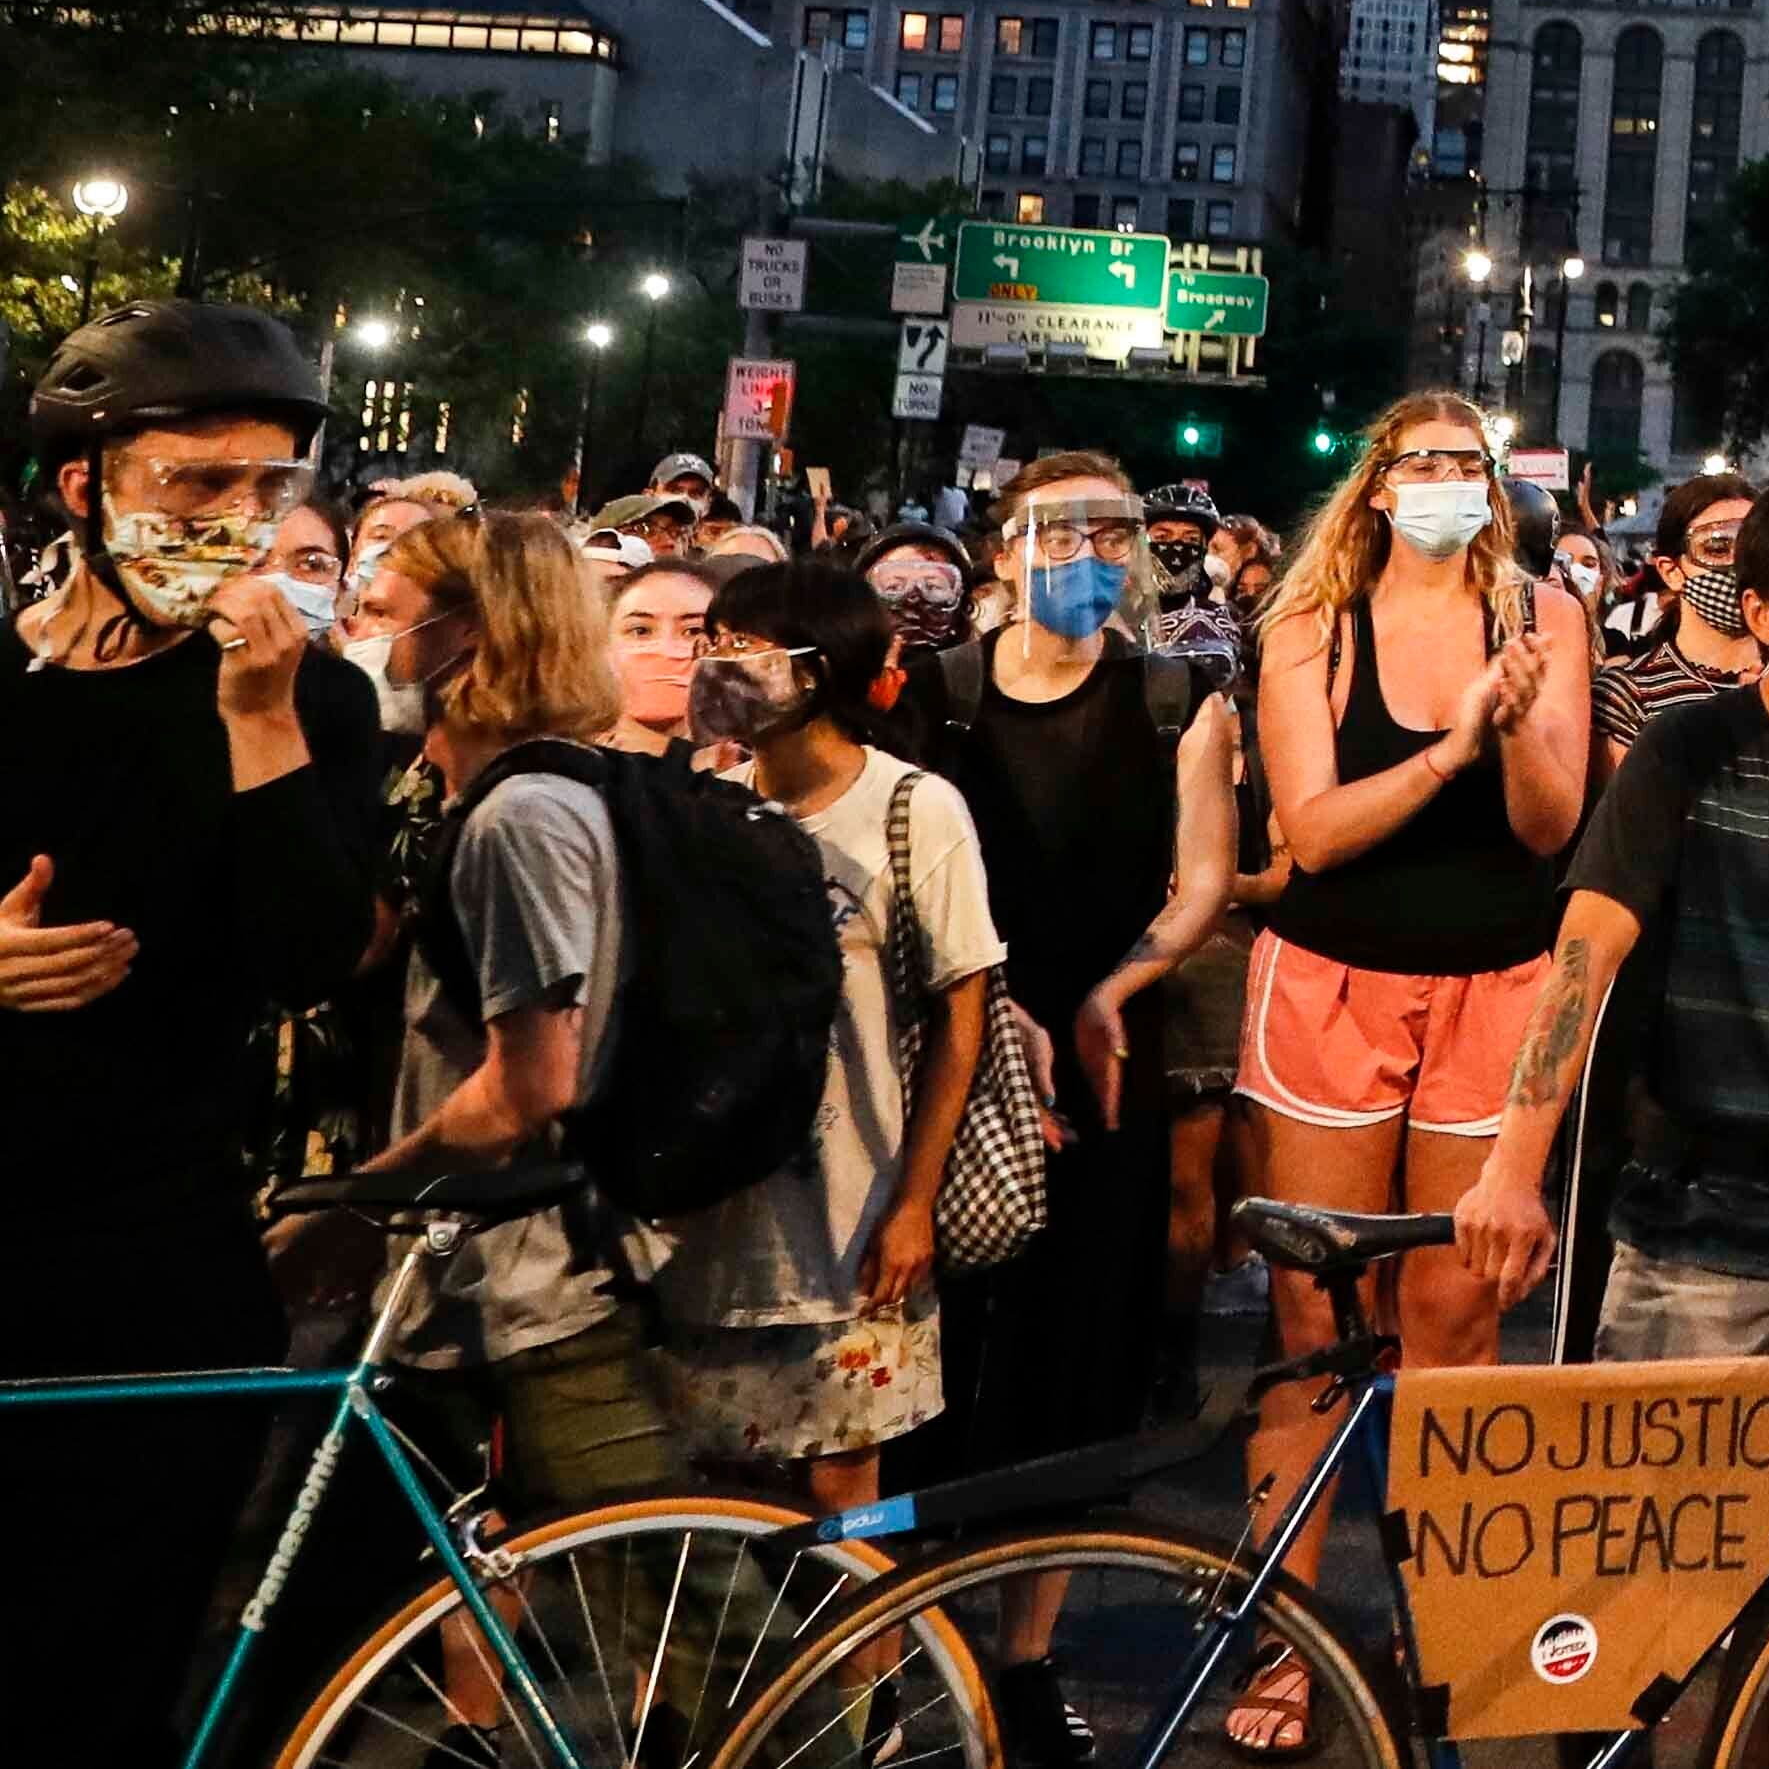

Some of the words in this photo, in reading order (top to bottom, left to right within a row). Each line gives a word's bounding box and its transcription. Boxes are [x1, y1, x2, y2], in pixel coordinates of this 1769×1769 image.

[764, 244, 784, 256] NO
[993, 230, 1097, 256] Brooklyn
[1109, 238, 1136, 257] Br
[746, 259, 801, 274] TRUCKS
[763, 277, 782, 290] OR
[990, 283, 1038, 300] ONLY
[748, 292, 793, 305] BUSES
[1176, 289, 1256, 310] Broadway
[736, 365, 789, 380] WEIGHT
[909, 382, 929, 395] NO
[1420, 1404, 1536, 1477] NO
[241, 1432, 344, 1632] Panasonic
[1415, 1502, 1536, 1579] NO
[1552, 1493, 1751, 1577] PEACE
